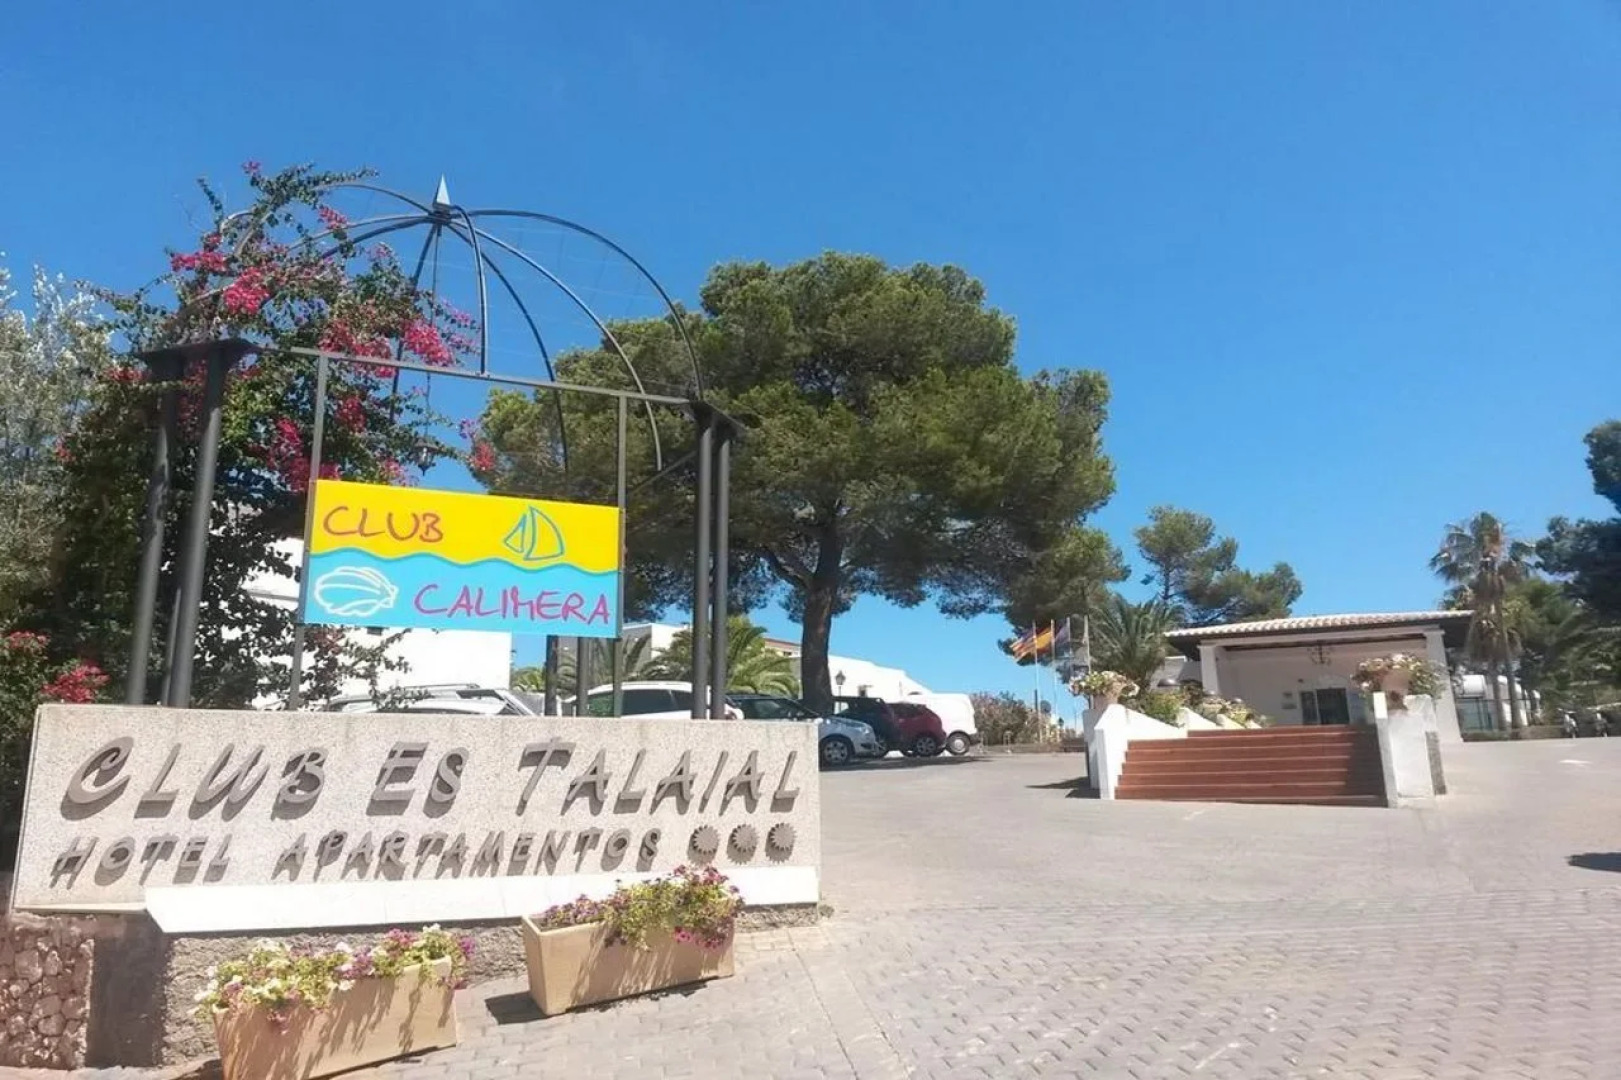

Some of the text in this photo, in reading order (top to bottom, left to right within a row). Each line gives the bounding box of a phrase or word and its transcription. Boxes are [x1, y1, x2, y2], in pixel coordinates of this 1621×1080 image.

[322, 505, 444, 543] CLUB
[413, 584, 611, 625] CALIMERA
[62, 737, 800, 819] CLUB ES TALAIAL
[50, 828, 661, 887] HOTEL APARTAMENTOS
